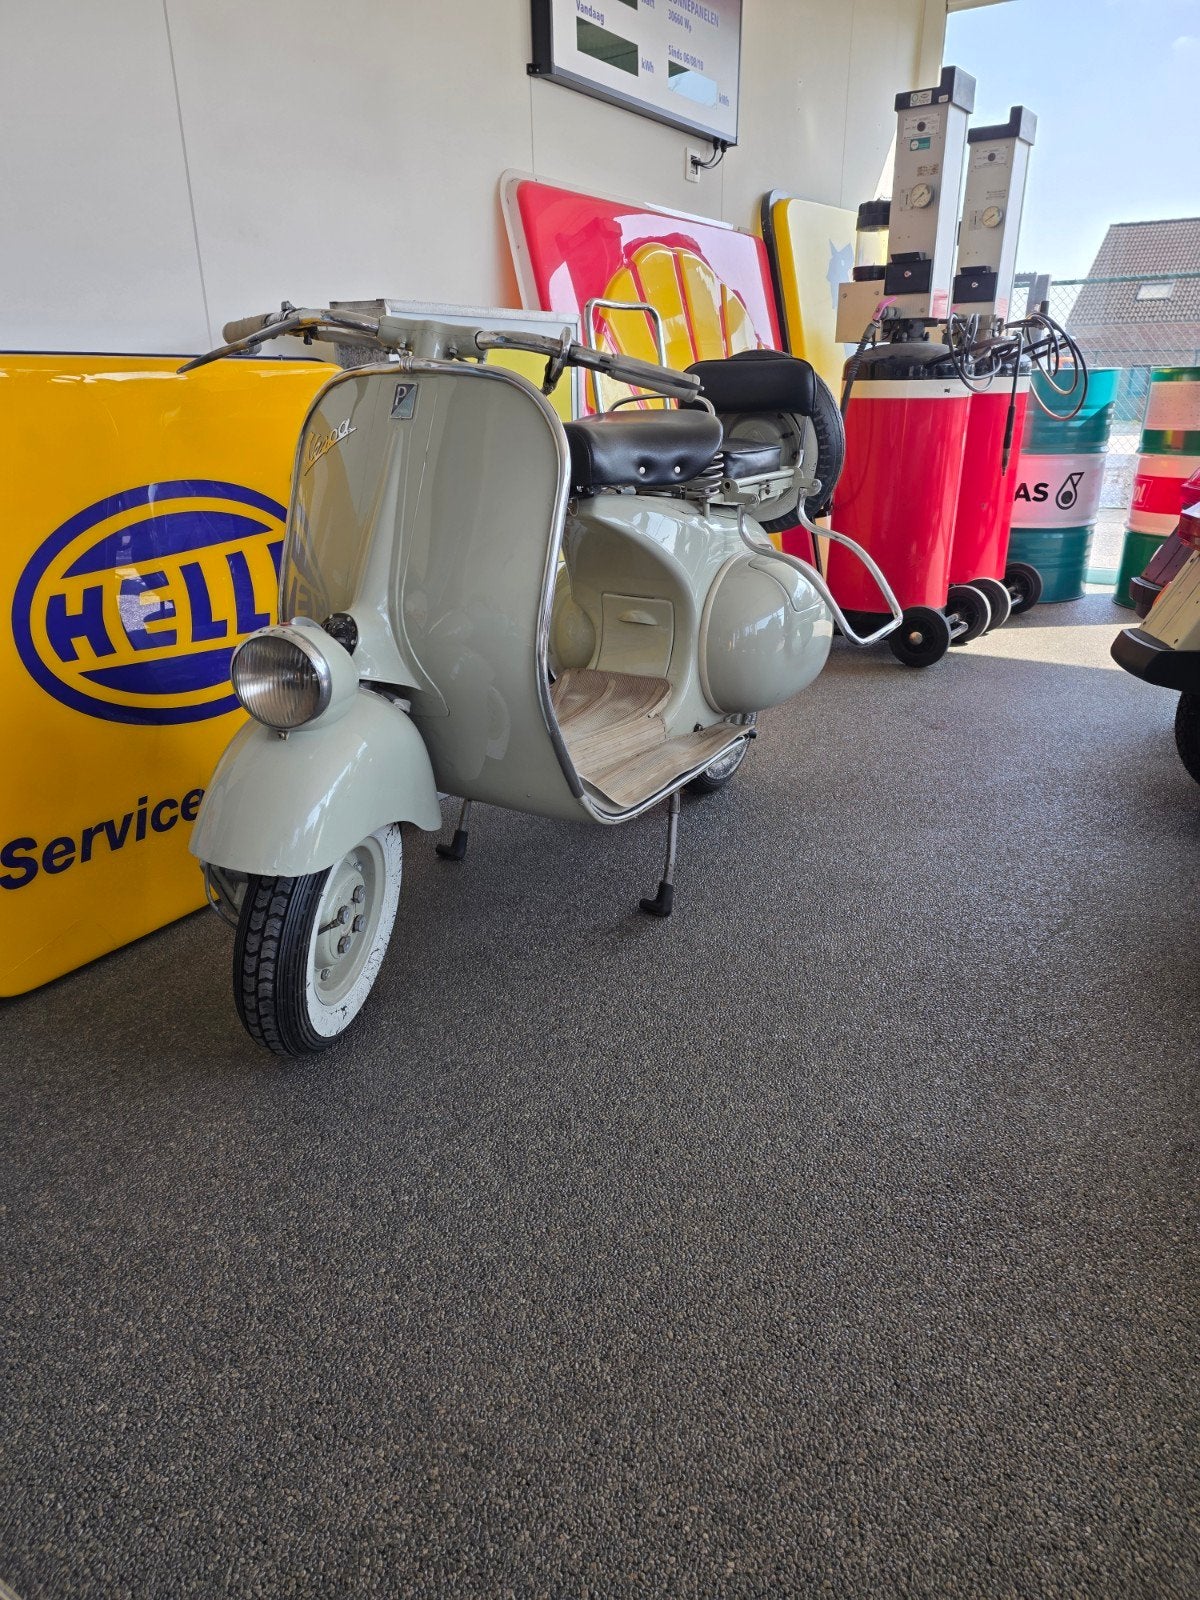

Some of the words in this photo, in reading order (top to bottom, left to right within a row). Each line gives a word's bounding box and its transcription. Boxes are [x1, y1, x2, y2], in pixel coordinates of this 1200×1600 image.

[576, 0, 604, 25] Vandaag
[667, 0, 719, 27] ONNEPANELEN
[641, 57, 654, 73] kWh
[668, 45, 683, 61] Sinds
[45, 541, 284, 662] HELL
[0, 788, 205, 890] Service
